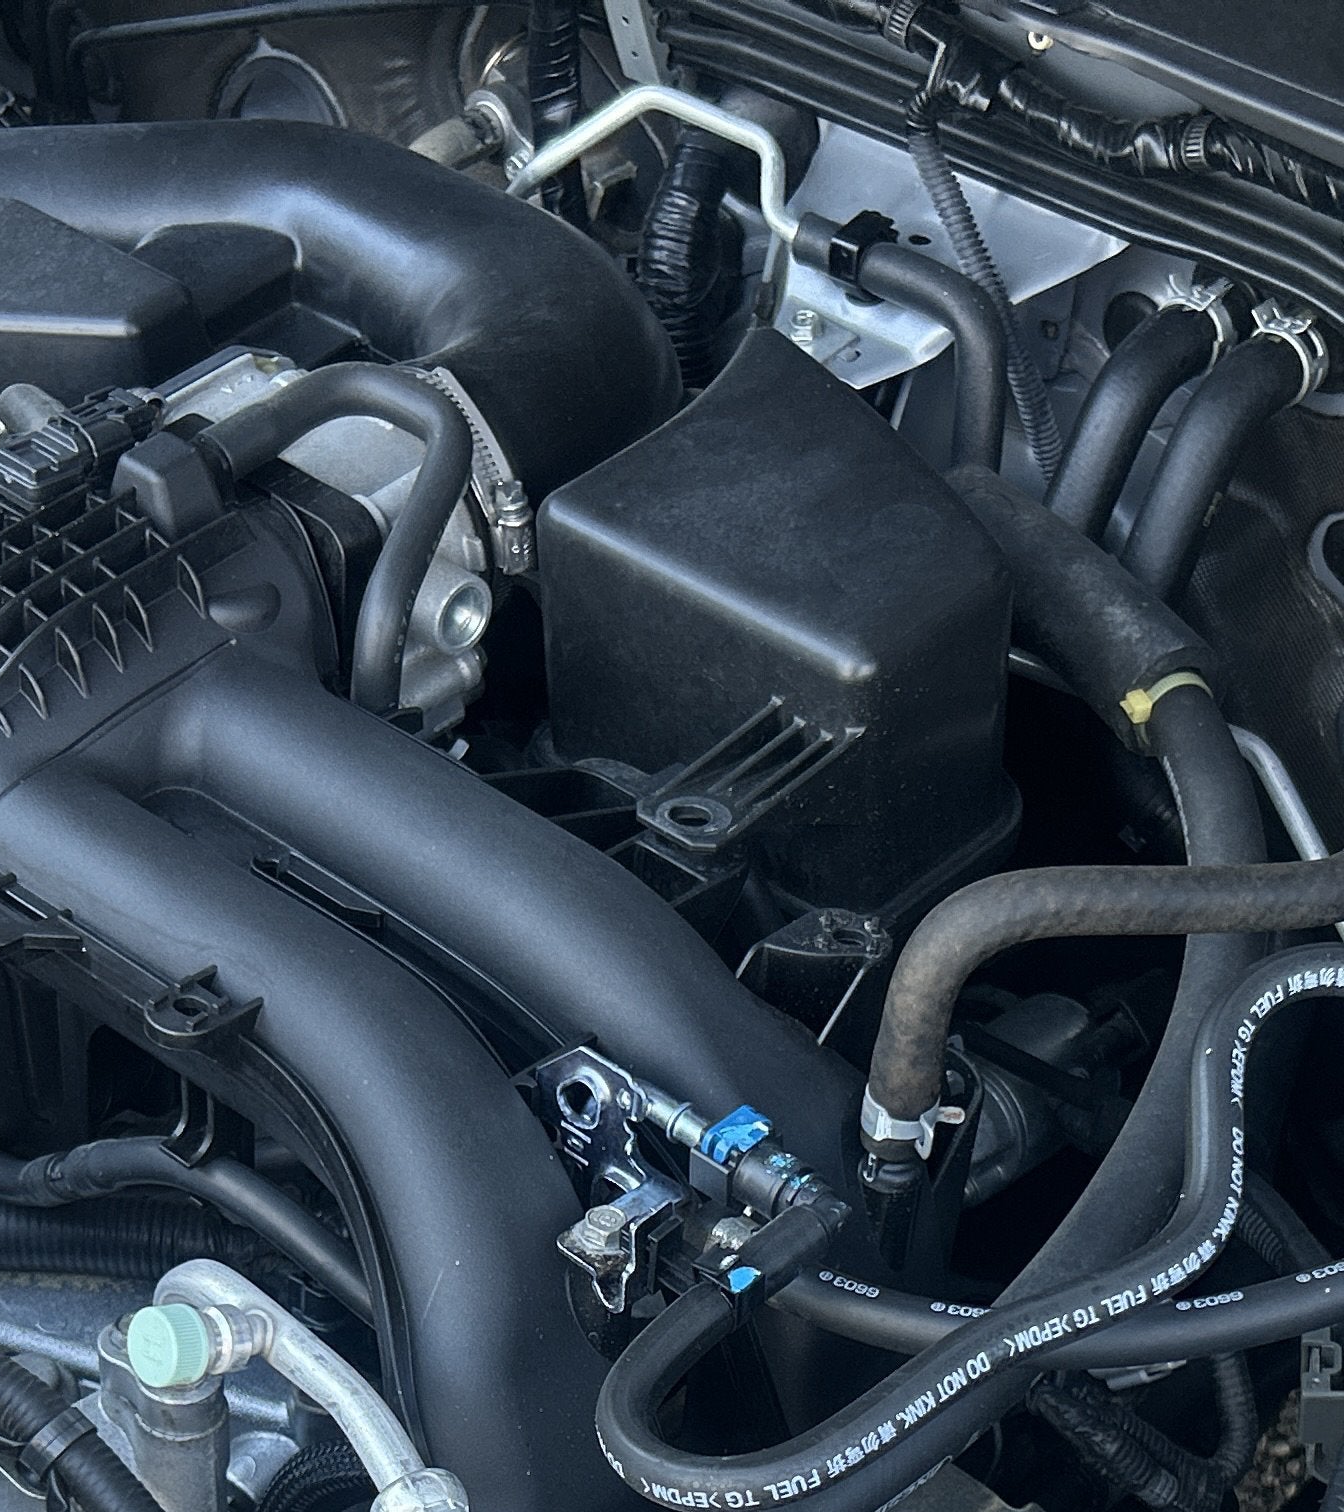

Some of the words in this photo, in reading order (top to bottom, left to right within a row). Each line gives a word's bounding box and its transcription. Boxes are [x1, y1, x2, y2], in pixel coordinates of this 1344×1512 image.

[1249, 984, 1285, 1019] FUEL
[1237, 1018, 1257, 1043] TG
[1231, 1126, 1245, 1156] DO
[1229, 1159, 1244, 1199] NOT
[833, 1277, 880, 1299] 6603
[1100, 1284, 1148, 1317] FUEL
[1193, 1290, 1245, 1308] 6603
[947, 1303, 993, 1319] 603
[1073, 1308, 1101, 1329] TG
[964, 1351, 991, 1381] DO
[938, 1366, 969, 1404] NOT
[726, 1489, 760, 1509] TG
[763, 1467, 822, 1502] FUEL
